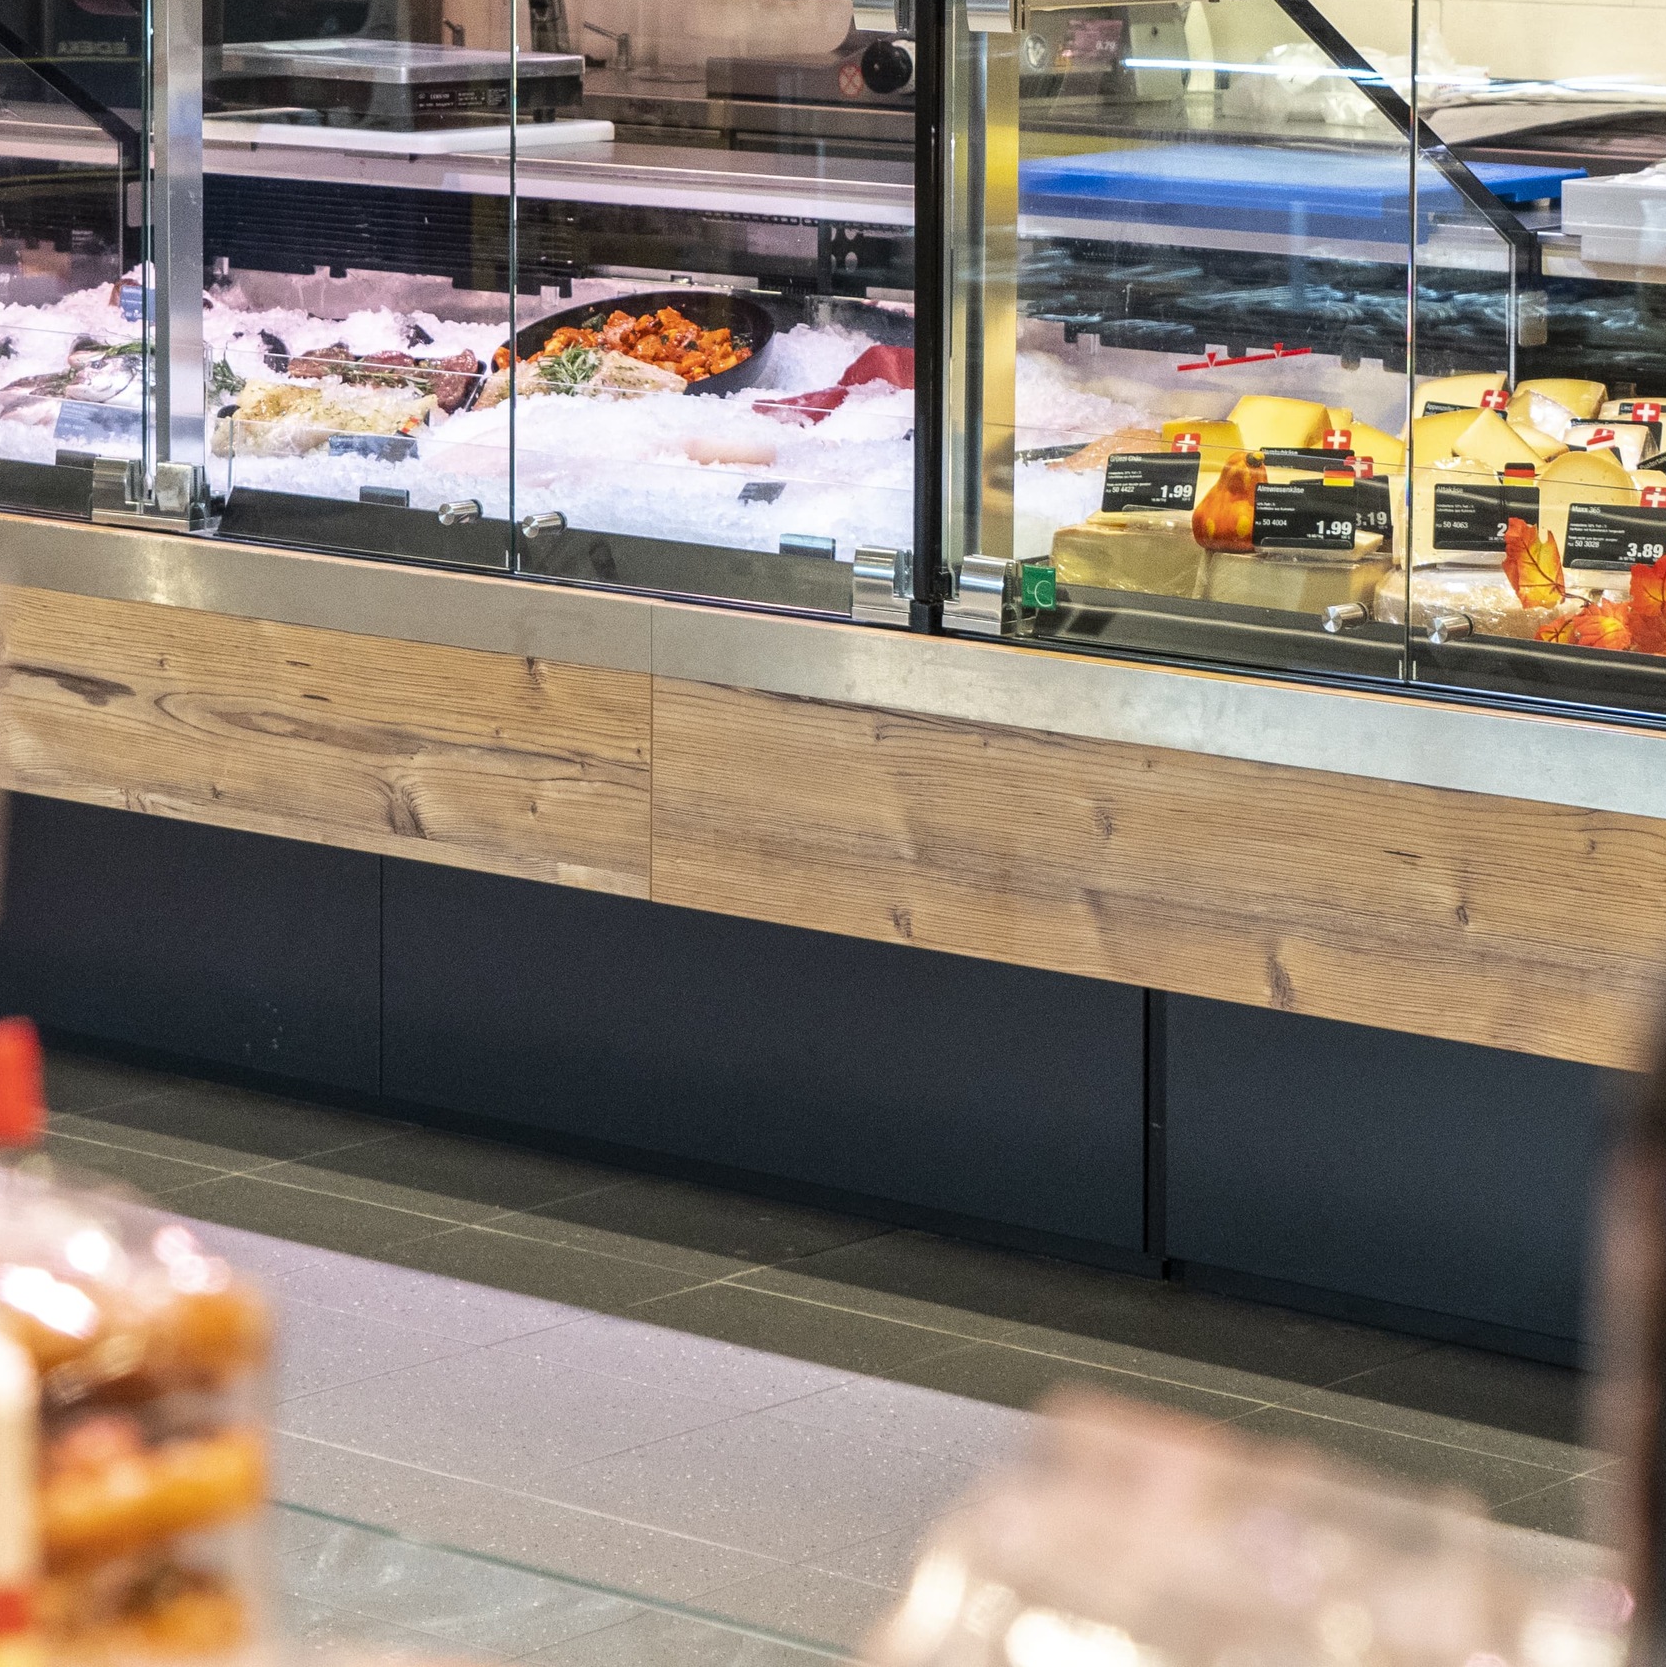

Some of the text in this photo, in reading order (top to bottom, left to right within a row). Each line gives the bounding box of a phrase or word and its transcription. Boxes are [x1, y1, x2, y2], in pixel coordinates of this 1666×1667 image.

[1160, 484, 1193, 499] 1.99
[1257, 485, 1305, 494] Almwiesenkäse
[1588, 506, 1601, 514] 365
[1316, 521, 1352, 535] 1.99
[1443, 521, 1452, 529] 50
[1452, 521, 1468, 529] 4063
[1627, 542, 1664, 558] 3.89
